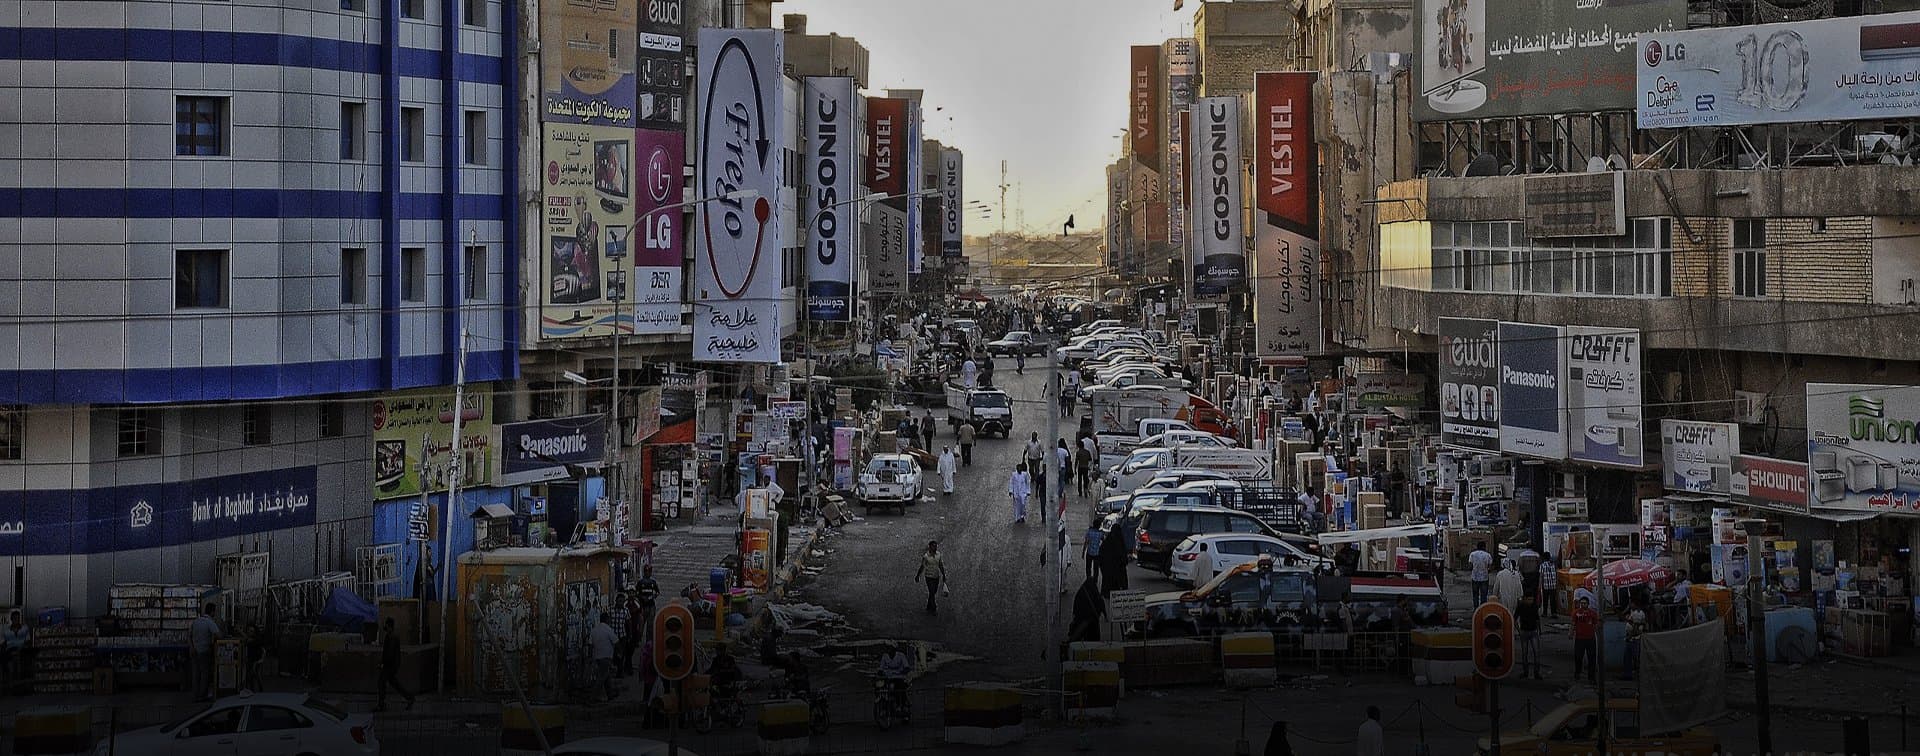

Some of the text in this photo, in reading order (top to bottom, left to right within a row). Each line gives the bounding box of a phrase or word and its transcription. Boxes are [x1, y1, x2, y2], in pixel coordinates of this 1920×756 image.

[1490, 38, 1512, 60] لديك
[1513, 34, 1548, 54] المفضلة
[1550, 27, 1576, 55] المحلية
[1578, 24, 1611, 48] المحطات
[1666, 44, 1685, 61] LG
[1657, 76, 1678, 94] Care
[1736, 30, 1809, 112] 10
[1836, 74, 1859, 88] البال
[1861, 72, 1883, 86] راحة
[1886, 72, 1902, 86] من
[547, 97, 631, 124] مجموعة الكويت المتحدة
[1137, 64, 1149, 139] VESTEL
[1647, 91, 1674, 110] Delight
[875, 116, 892, 182] VESTEL
[1271, 99, 1294, 195] VESTEL
[716, 101, 749, 239] Frego
[818, 99, 836, 265] GOSONIC
[1210, 103, 1231, 240] GOSONIC
[645, 214, 671, 249] LG
[879, 209, 889, 263] تكنولوجيا
[1278, 239, 1295, 314] تكنولوجيا
[1299, 246, 1314, 302] ترافقك
[711, 307, 756, 328] علامة
[708, 331, 758, 359] خليجية
[1503, 365, 1556, 390] Panasonic
[521, 429, 587, 461] Panasonic
[1750, 469, 1806, 493] SHOWNIC
[192, 492, 254, 523] Bank of Baghdad
[258, 485, 309, 517] مصرف بغداد
